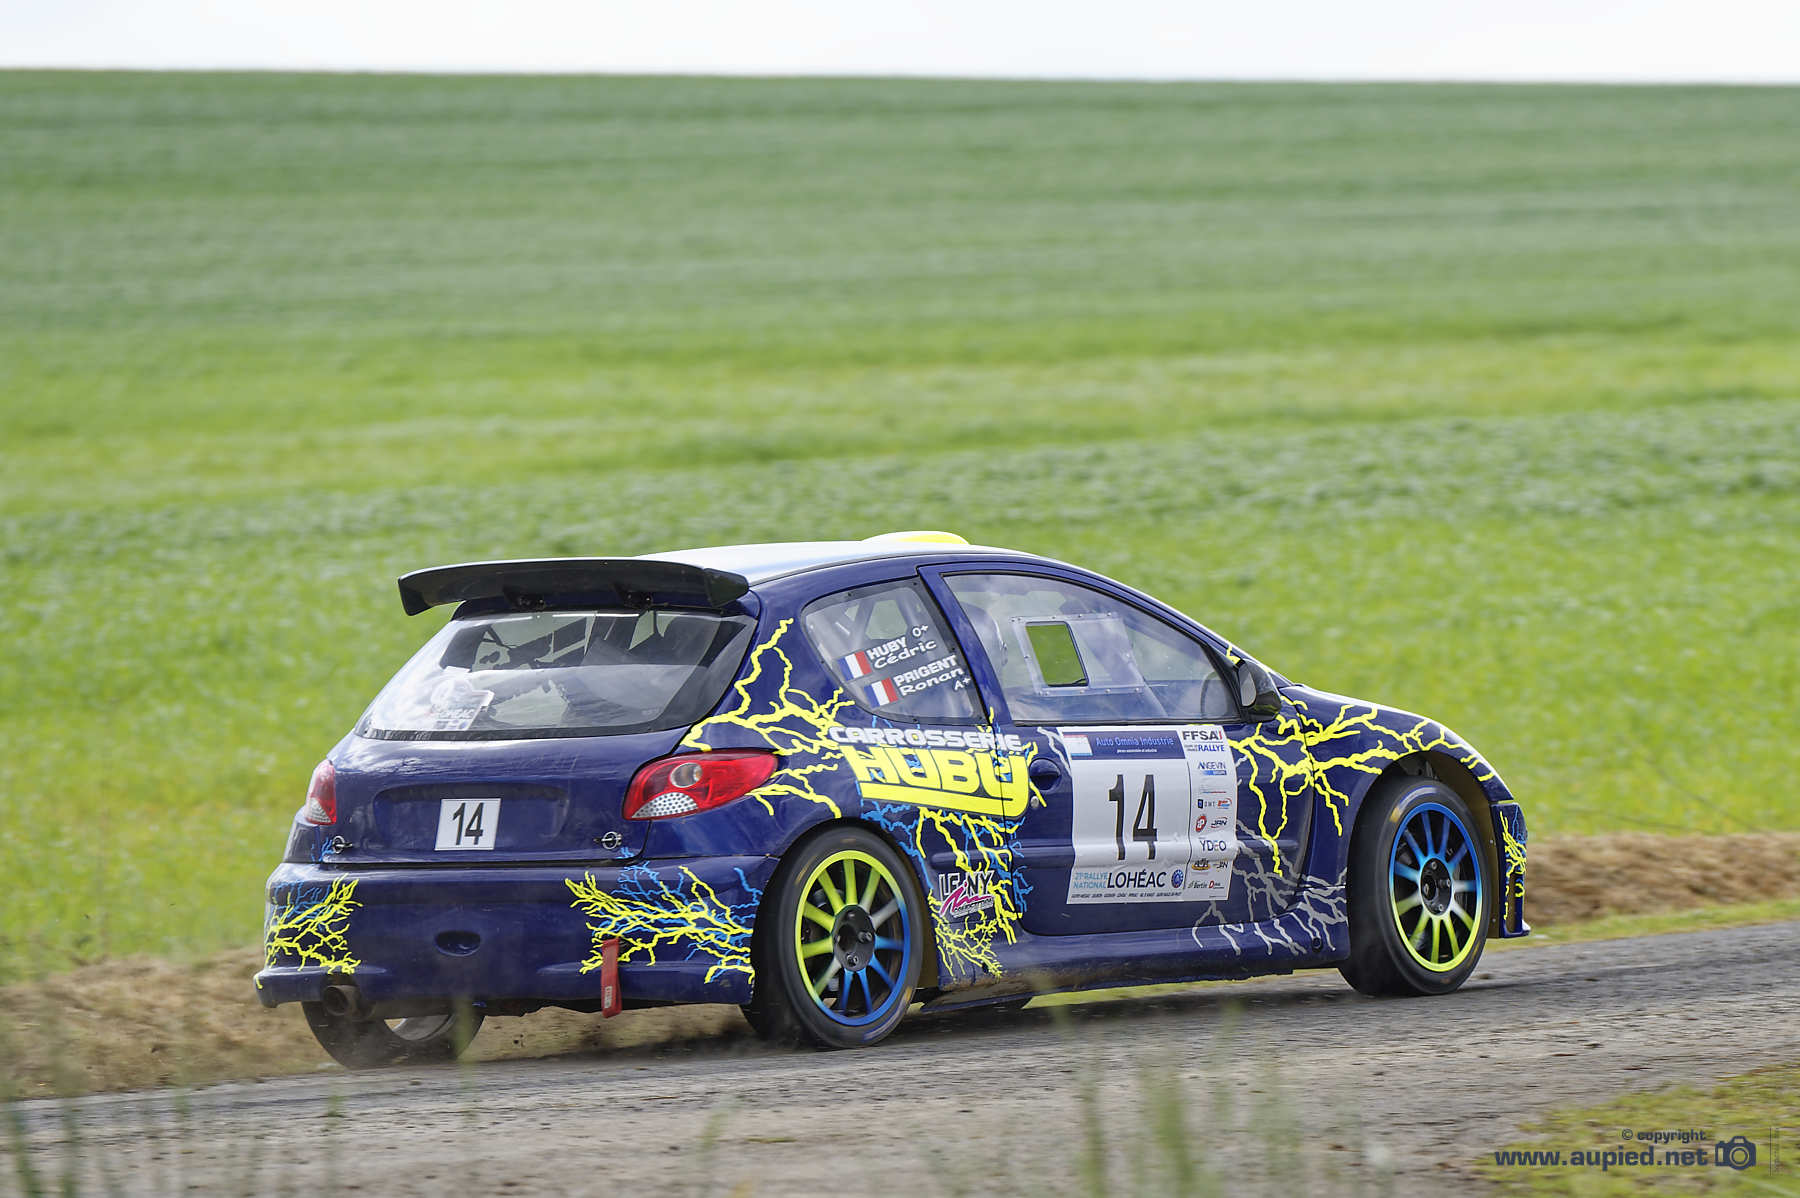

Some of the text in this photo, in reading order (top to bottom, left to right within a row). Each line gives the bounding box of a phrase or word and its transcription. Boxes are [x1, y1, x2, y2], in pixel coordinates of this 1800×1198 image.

[866, 636, 907, 661] HUBY
[873, 640, 937, 669] Cédric
[893, 654, 957, 687] PRIGENT
[899, 667, 965, 696] Ronan
[953, 677, 971, 691] A+
[828, 726, 1023, 752] CARROSSERIE
[1095, 735, 1174, 746] Auto Omnia Industrie
[1182, 730, 1219, 741] FFSA
[1198, 744, 1225, 752] RALLYE
[452, 802, 484, 846] 14
[1108, 774, 1158, 861] 14
[1073, 881, 1107, 889] NATIONAL
[1107, 868, 1167, 889] LOHÉAC
